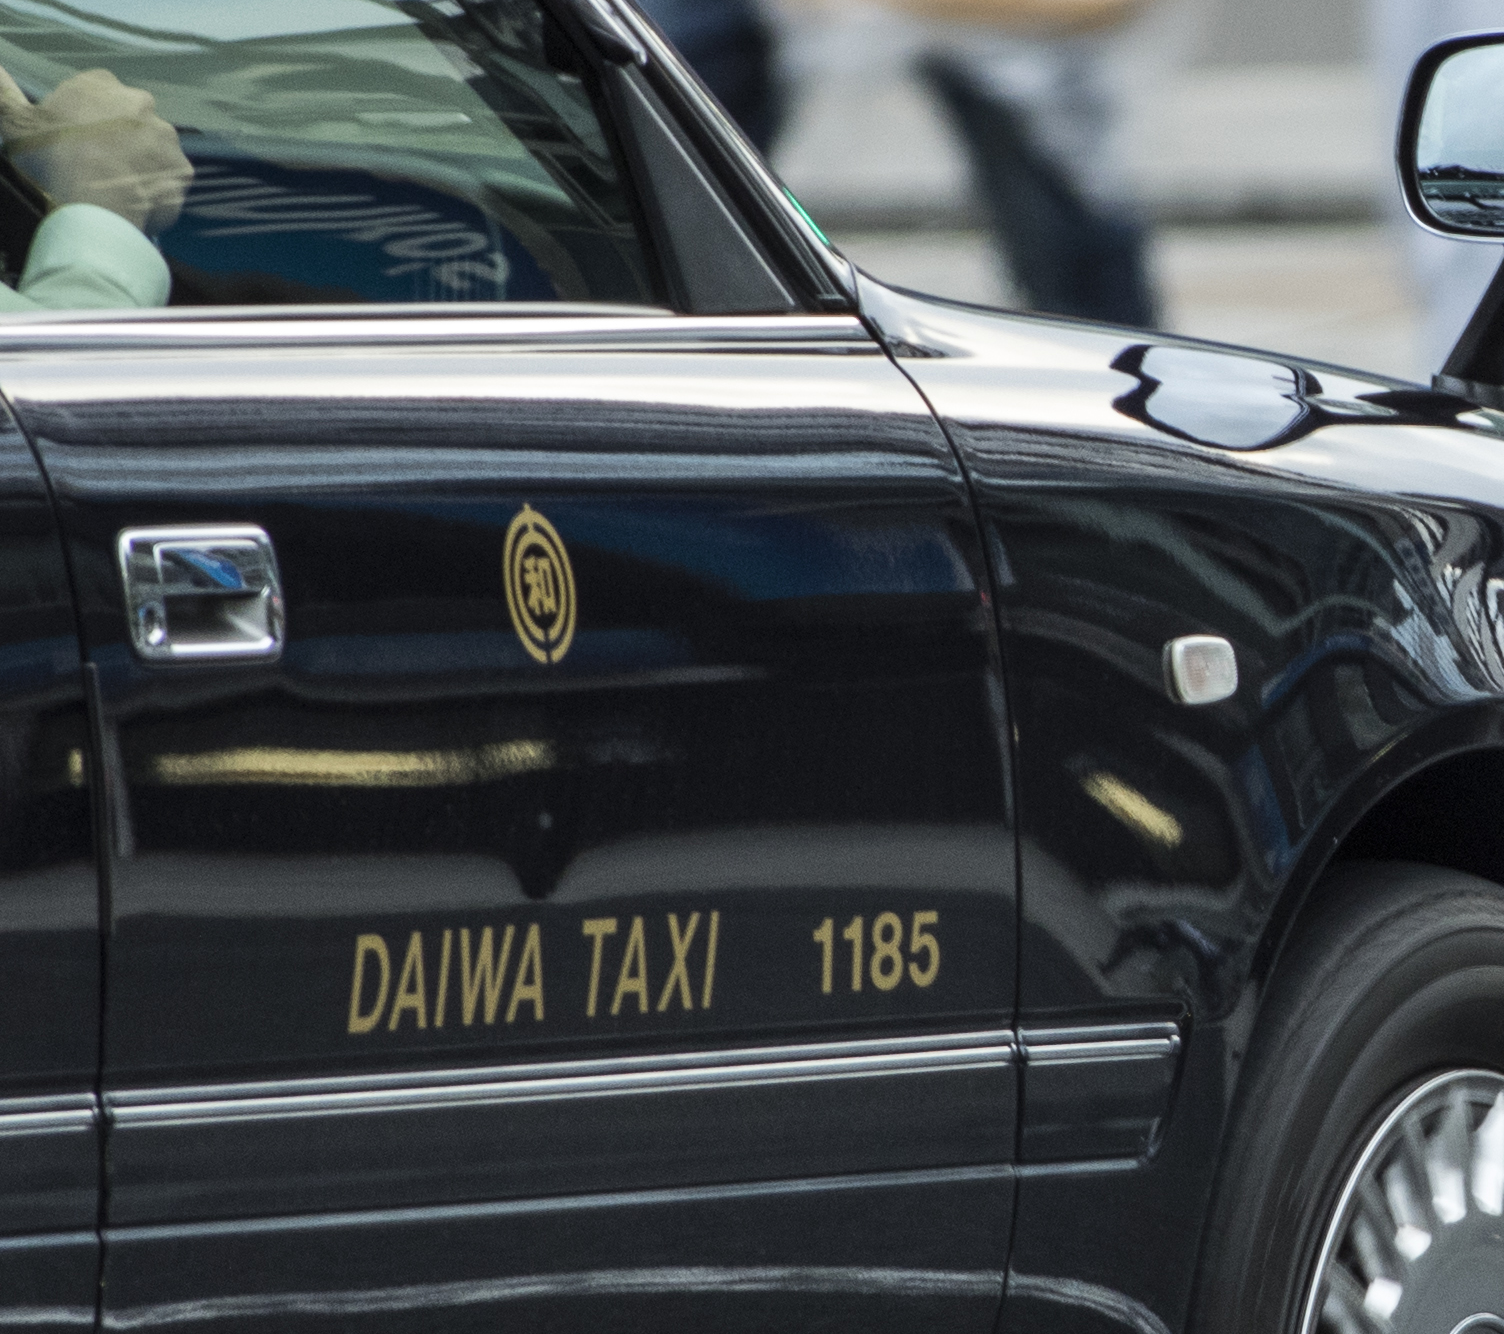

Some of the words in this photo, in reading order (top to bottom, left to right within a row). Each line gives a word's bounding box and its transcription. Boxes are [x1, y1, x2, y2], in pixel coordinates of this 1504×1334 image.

[348, 923, 545, 1034] DAIWA
[582, 911, 720, 1017] TAXI
[813, 910, 941, 994] 1185
